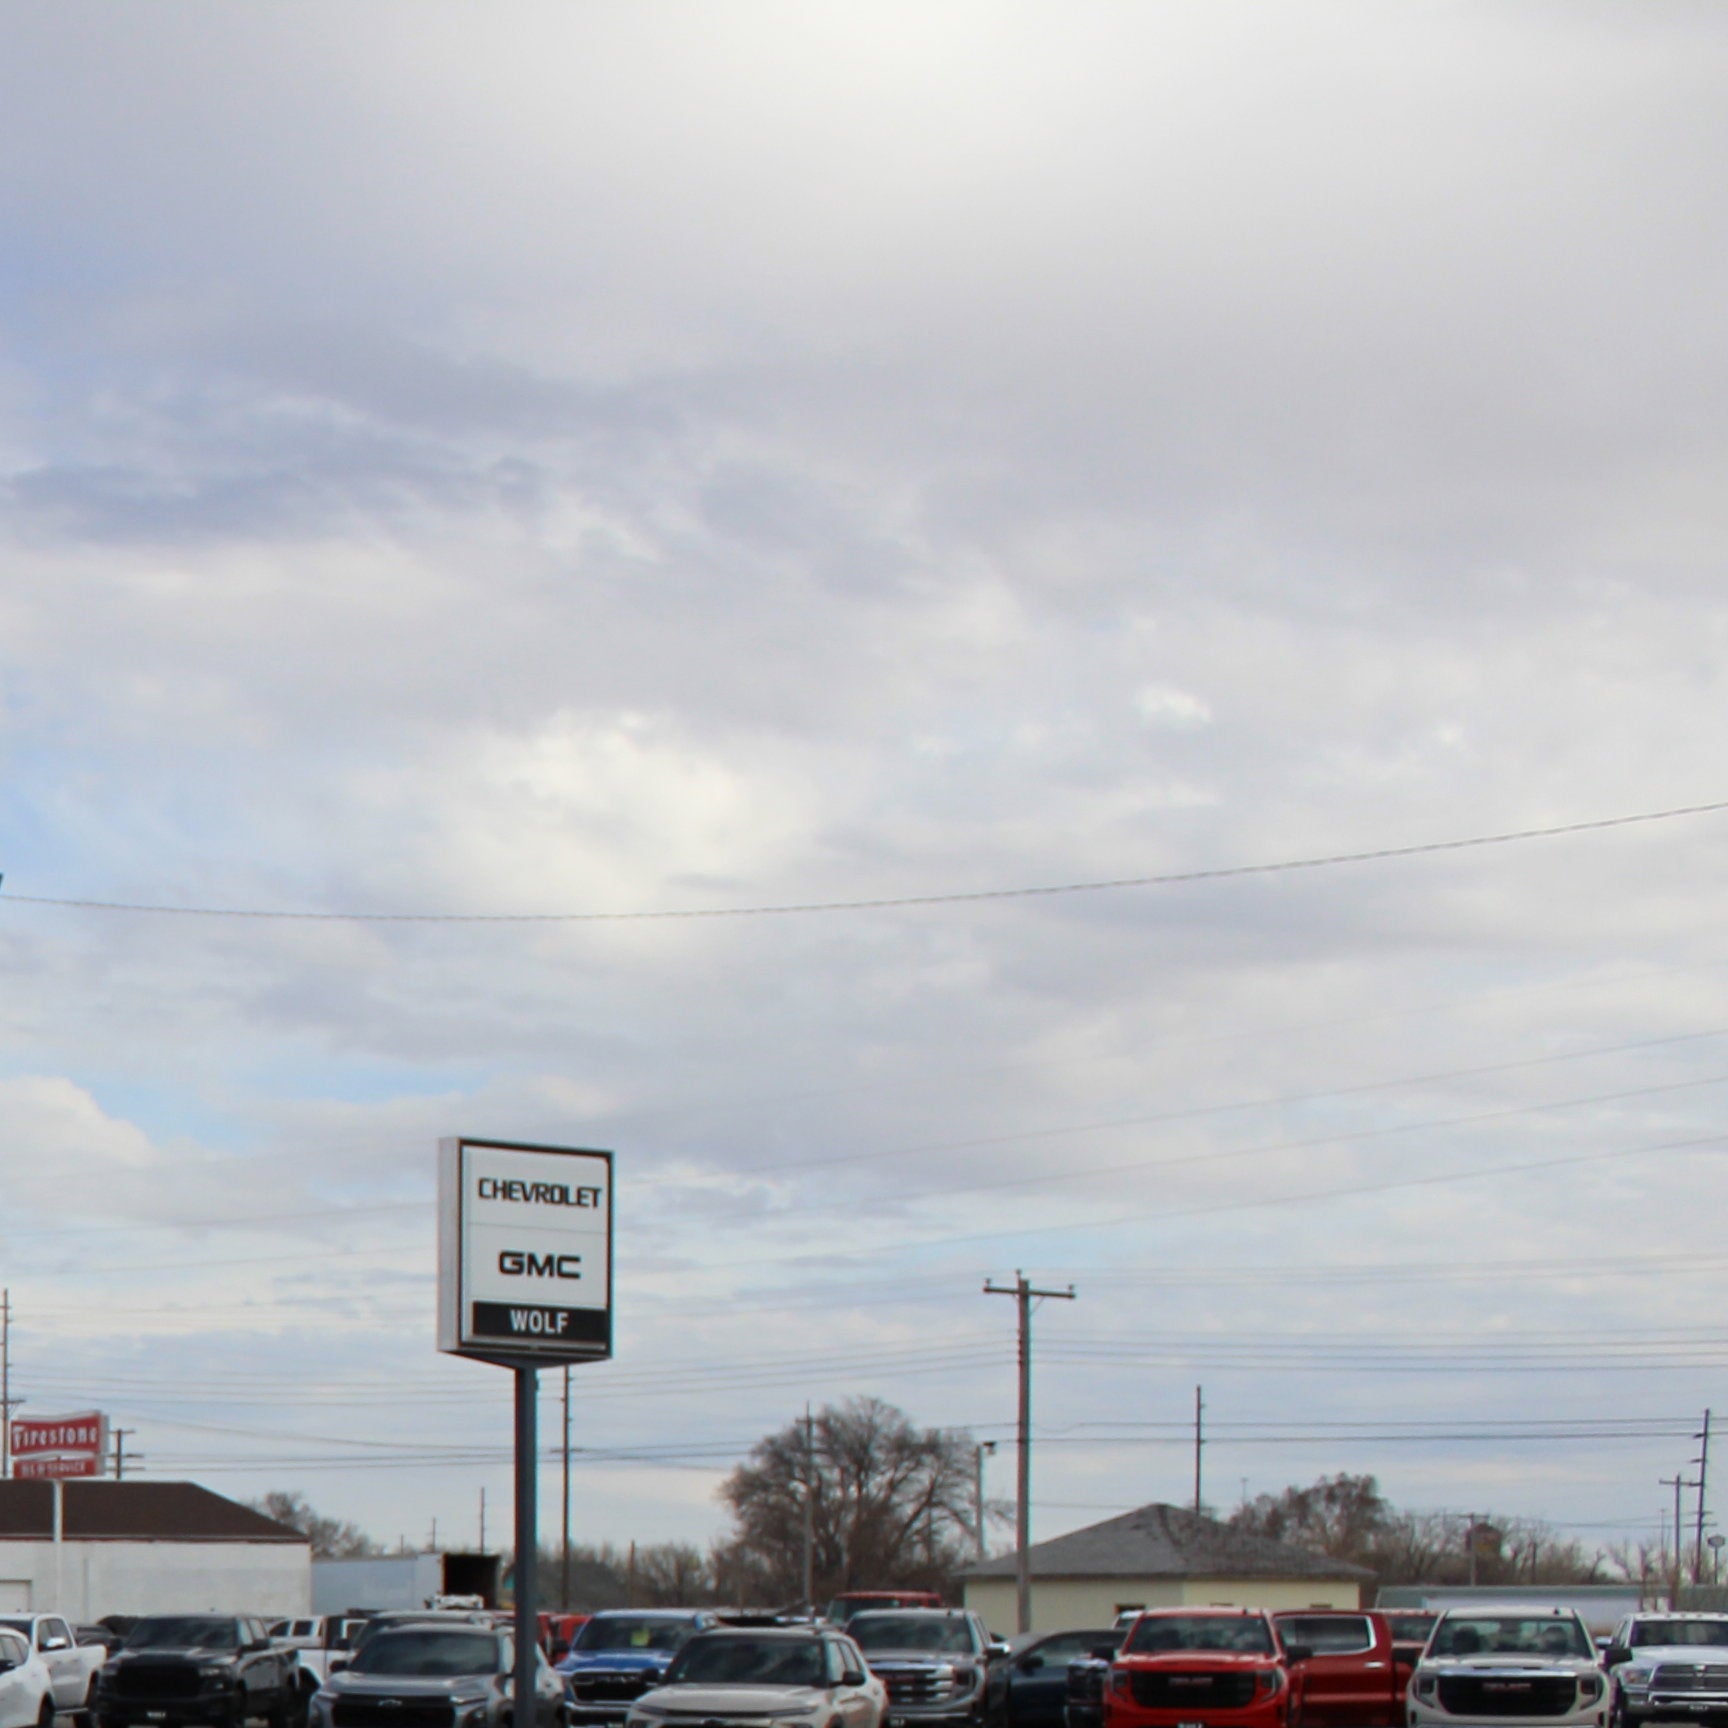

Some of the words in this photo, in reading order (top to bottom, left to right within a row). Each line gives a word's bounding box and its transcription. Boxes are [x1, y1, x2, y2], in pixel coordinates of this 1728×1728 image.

[478, 1177, 603, 1208] CHEVROLET
[499, 1251, 582, 1280] GMC
[510, 1308, 569, 1335] WOLF
[13, 1426, 97, 1450] Firestone
